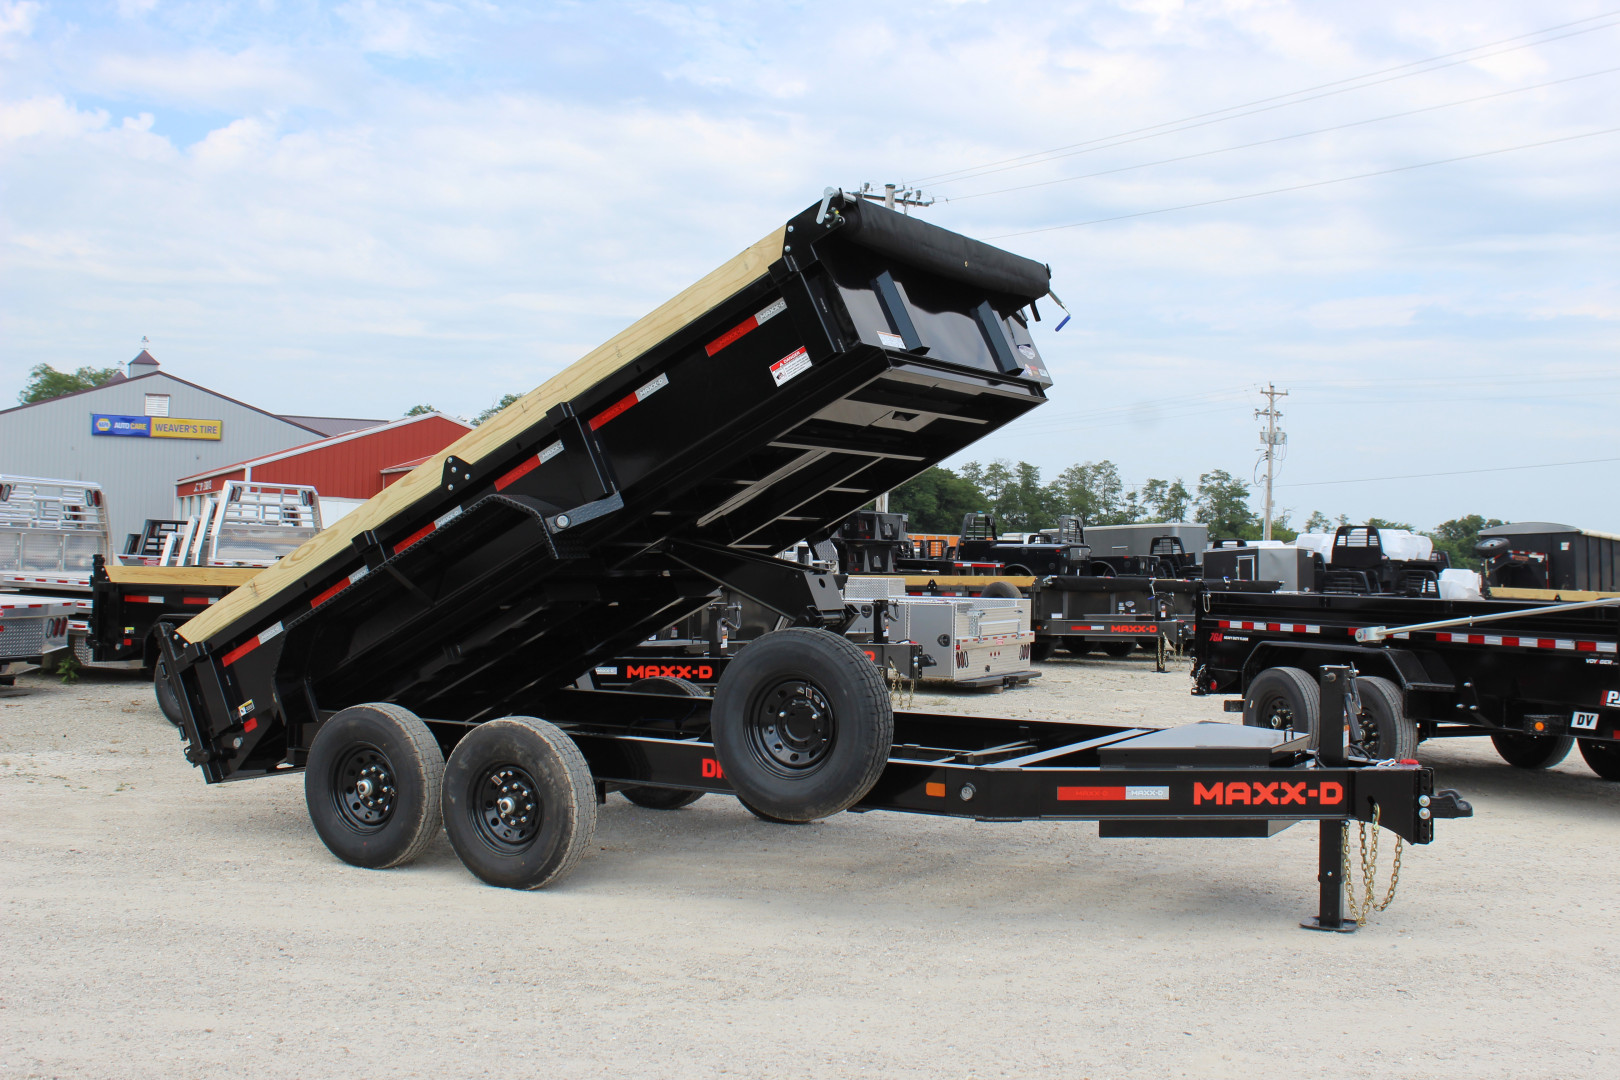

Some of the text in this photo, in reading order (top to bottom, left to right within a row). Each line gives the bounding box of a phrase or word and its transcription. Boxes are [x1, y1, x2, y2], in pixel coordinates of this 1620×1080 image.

[759, 301, 786, 320] MAXX-D
[783, 350, 801, 364] DANGER
[639, 377, 664, 397] MAXX-D
[155, 423, 218, 434] WEAVER'S TIRE
[1111, 625, 1158, 633] MAXX-D
[1209, 632, 1224, 642] 7GA
[626, 665, 713, 679] MAXX-D
[1577, 713, 1594, 726] DV
[1193, 782, 1344, 805] MAXX-D
